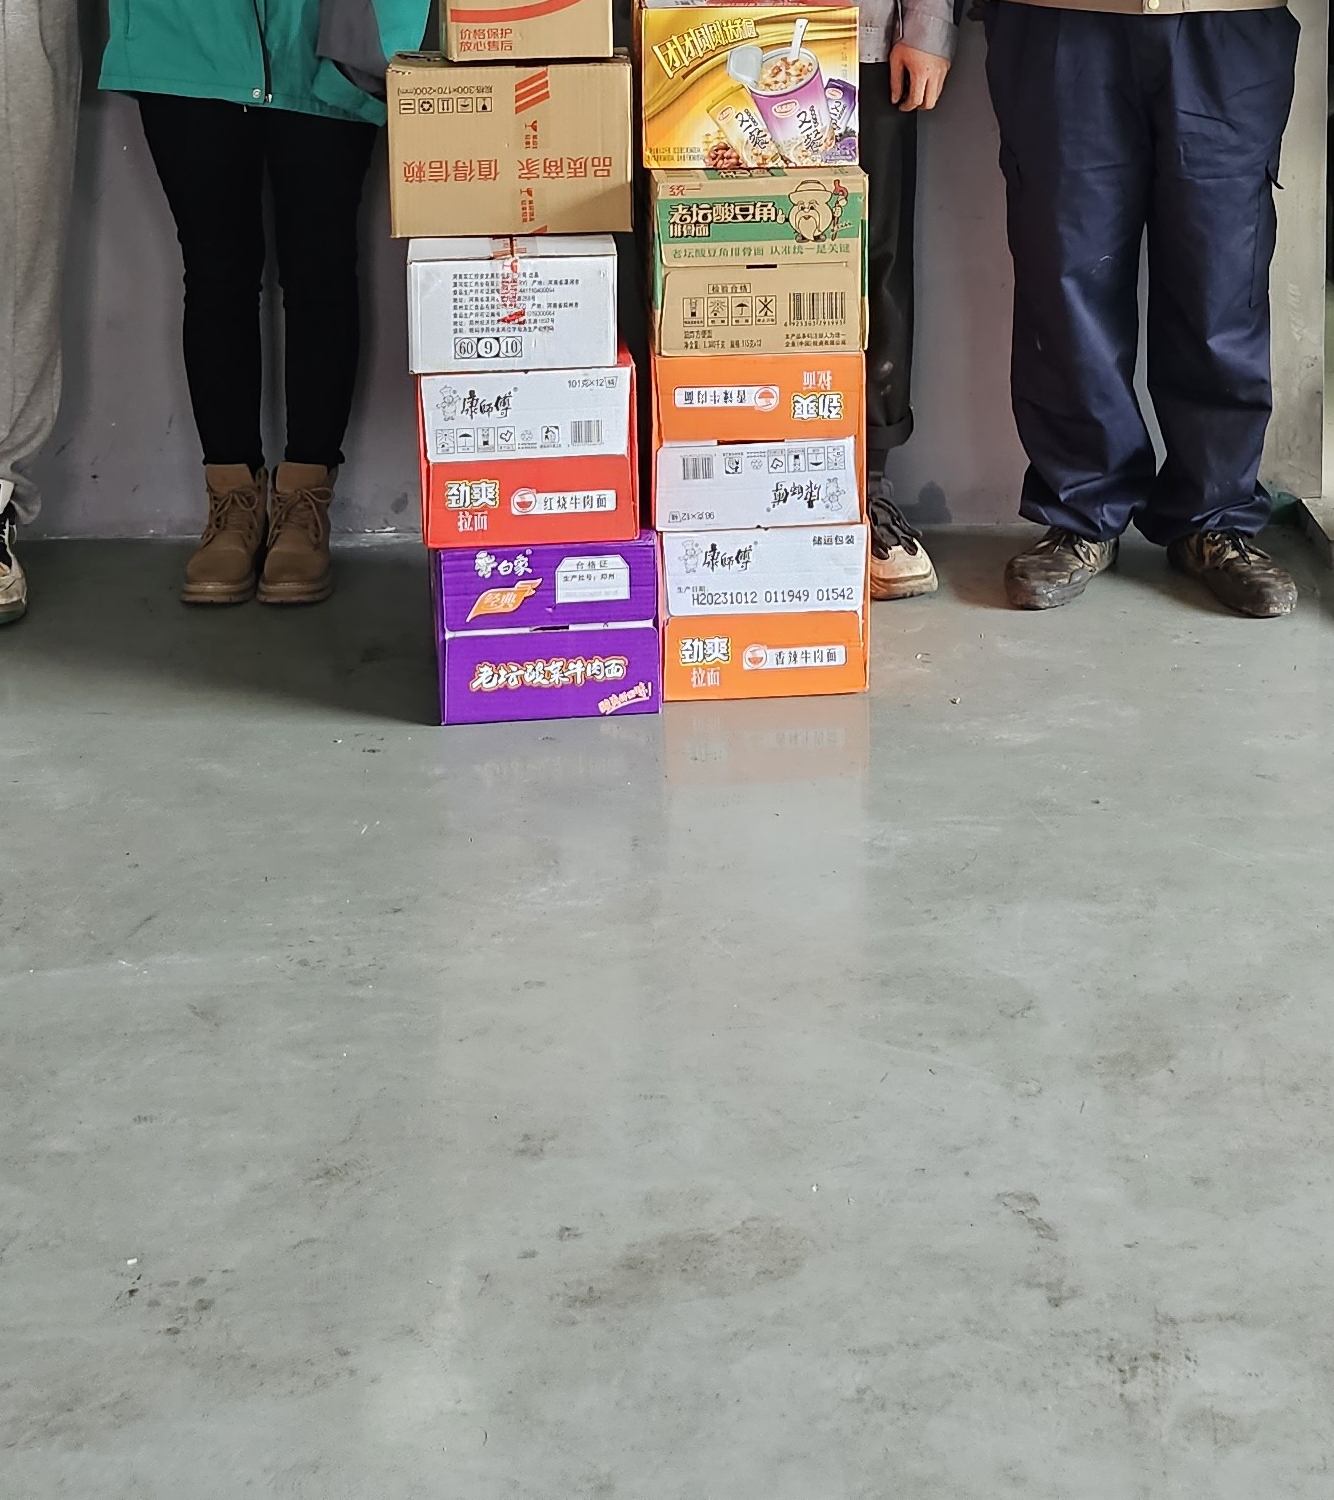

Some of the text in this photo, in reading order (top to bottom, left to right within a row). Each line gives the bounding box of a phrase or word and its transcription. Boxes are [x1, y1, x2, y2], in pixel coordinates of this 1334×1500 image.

[460, 27, 513, 40] 价格保护
[459, 40, 513, 52] 放心售后
[403, 156, 613, 183] 品质商家 值得信赖
[669, 184, 701, 197] 统一
[669, 202, 778, 224] 老坛酸豆角
[669, 223, 710, 238] 排骨面
[673, 248, 764, 259] 老坛酸豆角排骨面
[459, 339, 517, 355] 60 9 10
[802, 370, 833, 391] 拉面
[684, 389, 747, 405] 香辣牛肉面
[791, 392, 844, 420] 劲爽
[446, 480, 499, 509] 劲爽
[543, 493, 607, 510] 红烧牛肉面
[458, 511, 489, 532] 拉面
[812, 535, 855, 546] 储运包装
[497, 553, 533, 577] 白象
[692, 586, 854, 606] H20231012 011949 01542
[680, 637, 730, 665] 劲爽
[774, 649, 838, 666] 香辣牛肉面
[471, 656, 626, 690] 老坛酸菜牛肉面
[691, 667, 721, 688] 拉面
